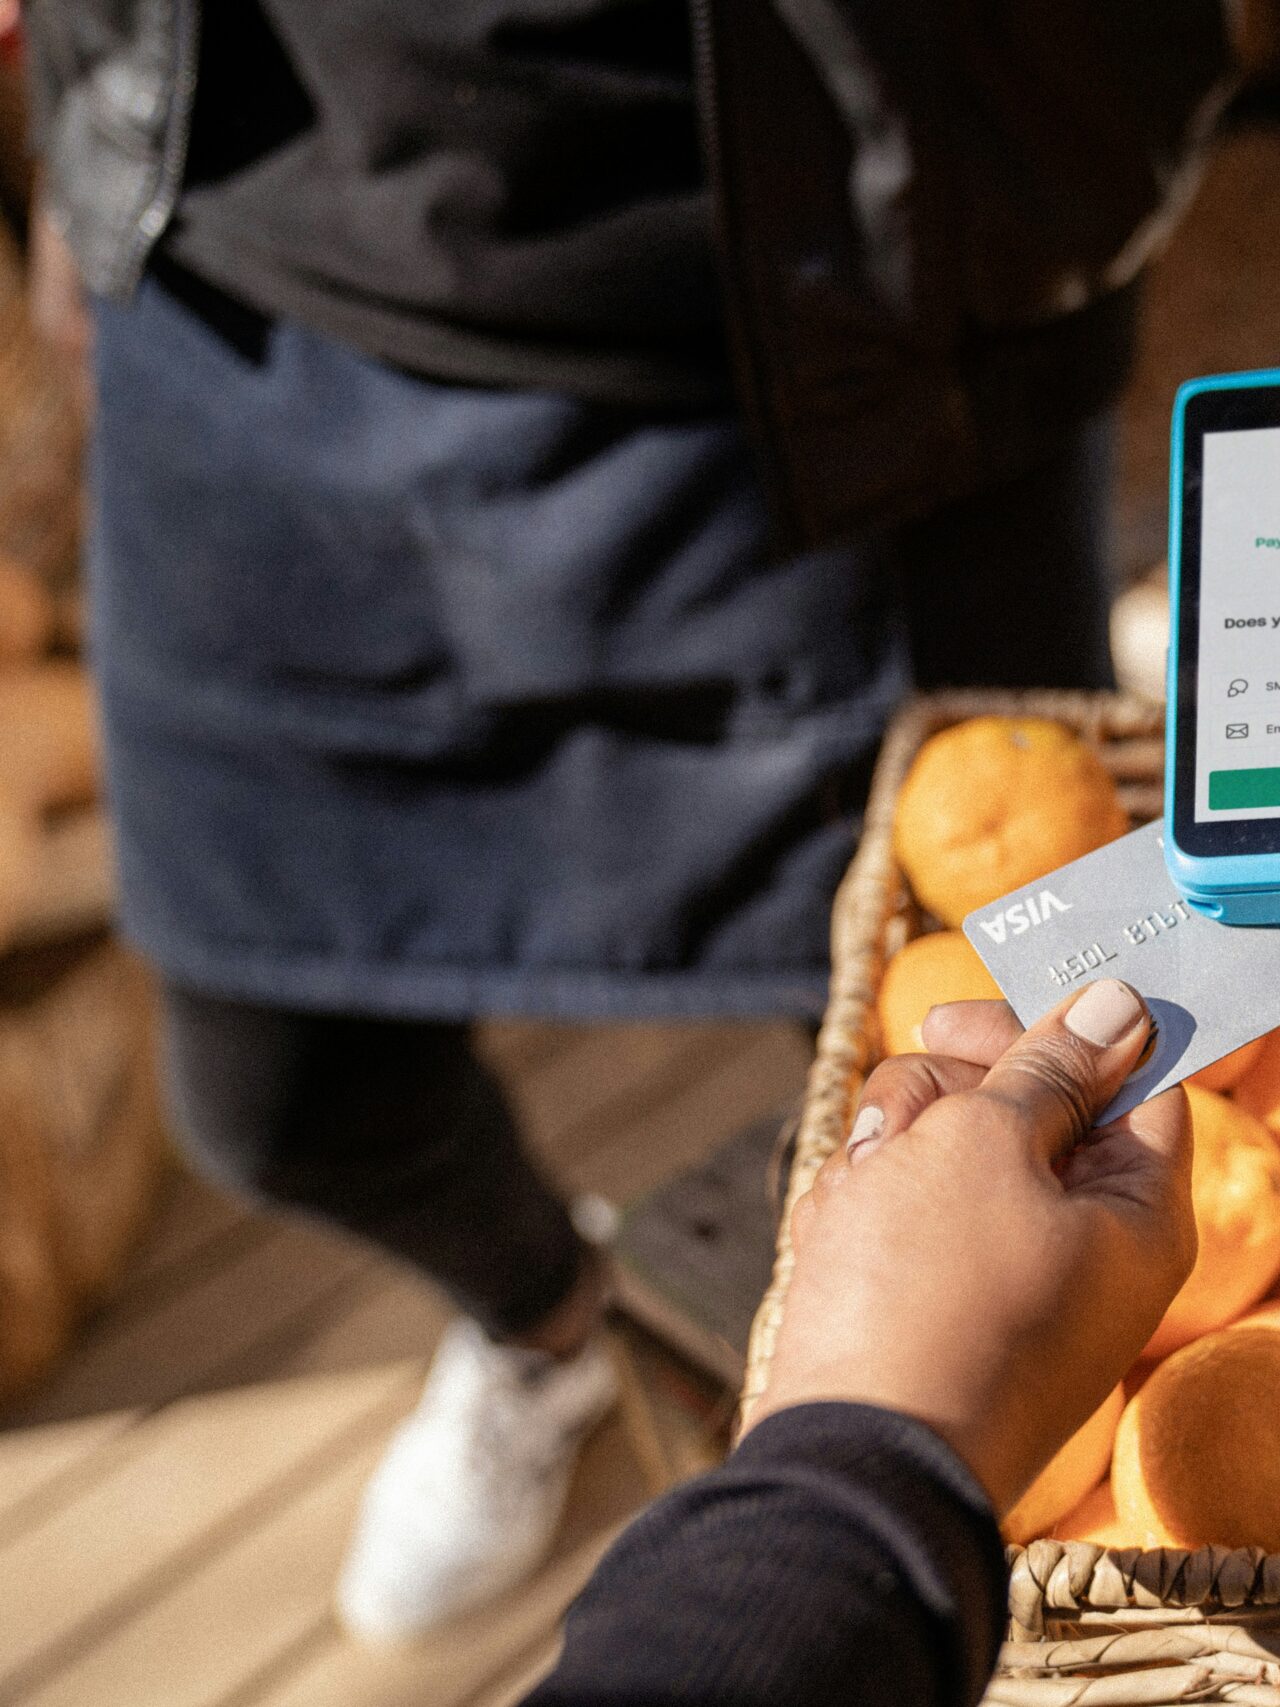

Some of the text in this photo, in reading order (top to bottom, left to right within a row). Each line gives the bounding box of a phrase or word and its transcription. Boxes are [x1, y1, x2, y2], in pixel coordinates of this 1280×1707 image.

[1224, 615, 1267, 630] Does
[979, 890, 1073, 944] VISA
[1048, 943, 1118, 986] 7054
